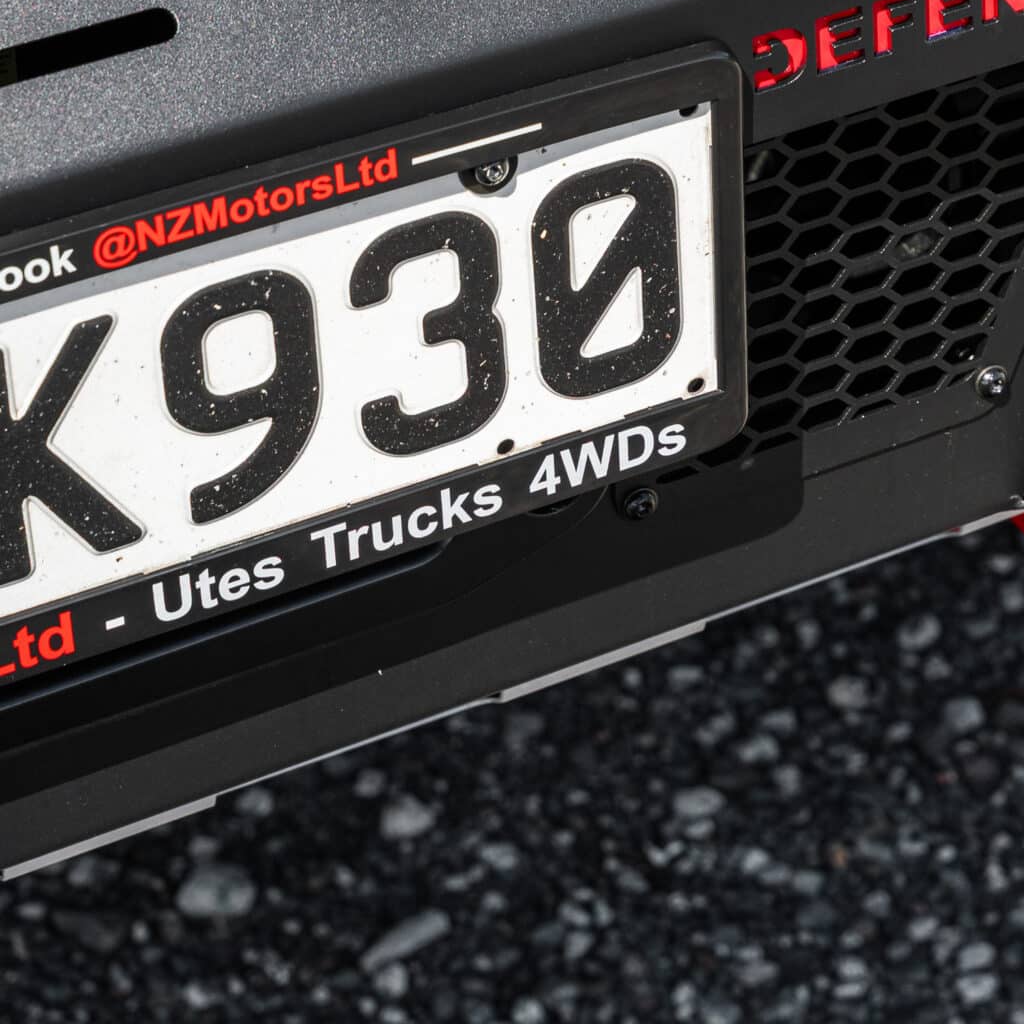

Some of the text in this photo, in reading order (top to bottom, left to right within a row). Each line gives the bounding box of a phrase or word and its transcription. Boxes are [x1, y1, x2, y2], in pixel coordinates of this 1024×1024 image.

[93, 147, 399, 270] @NZMotorsLtd
[0, 157, 685, 586] K930
[152, 555, 286, 622] Utes
[310, 483, 504, 569] Trucks
[528, 422, 688, 497] 4WDs
